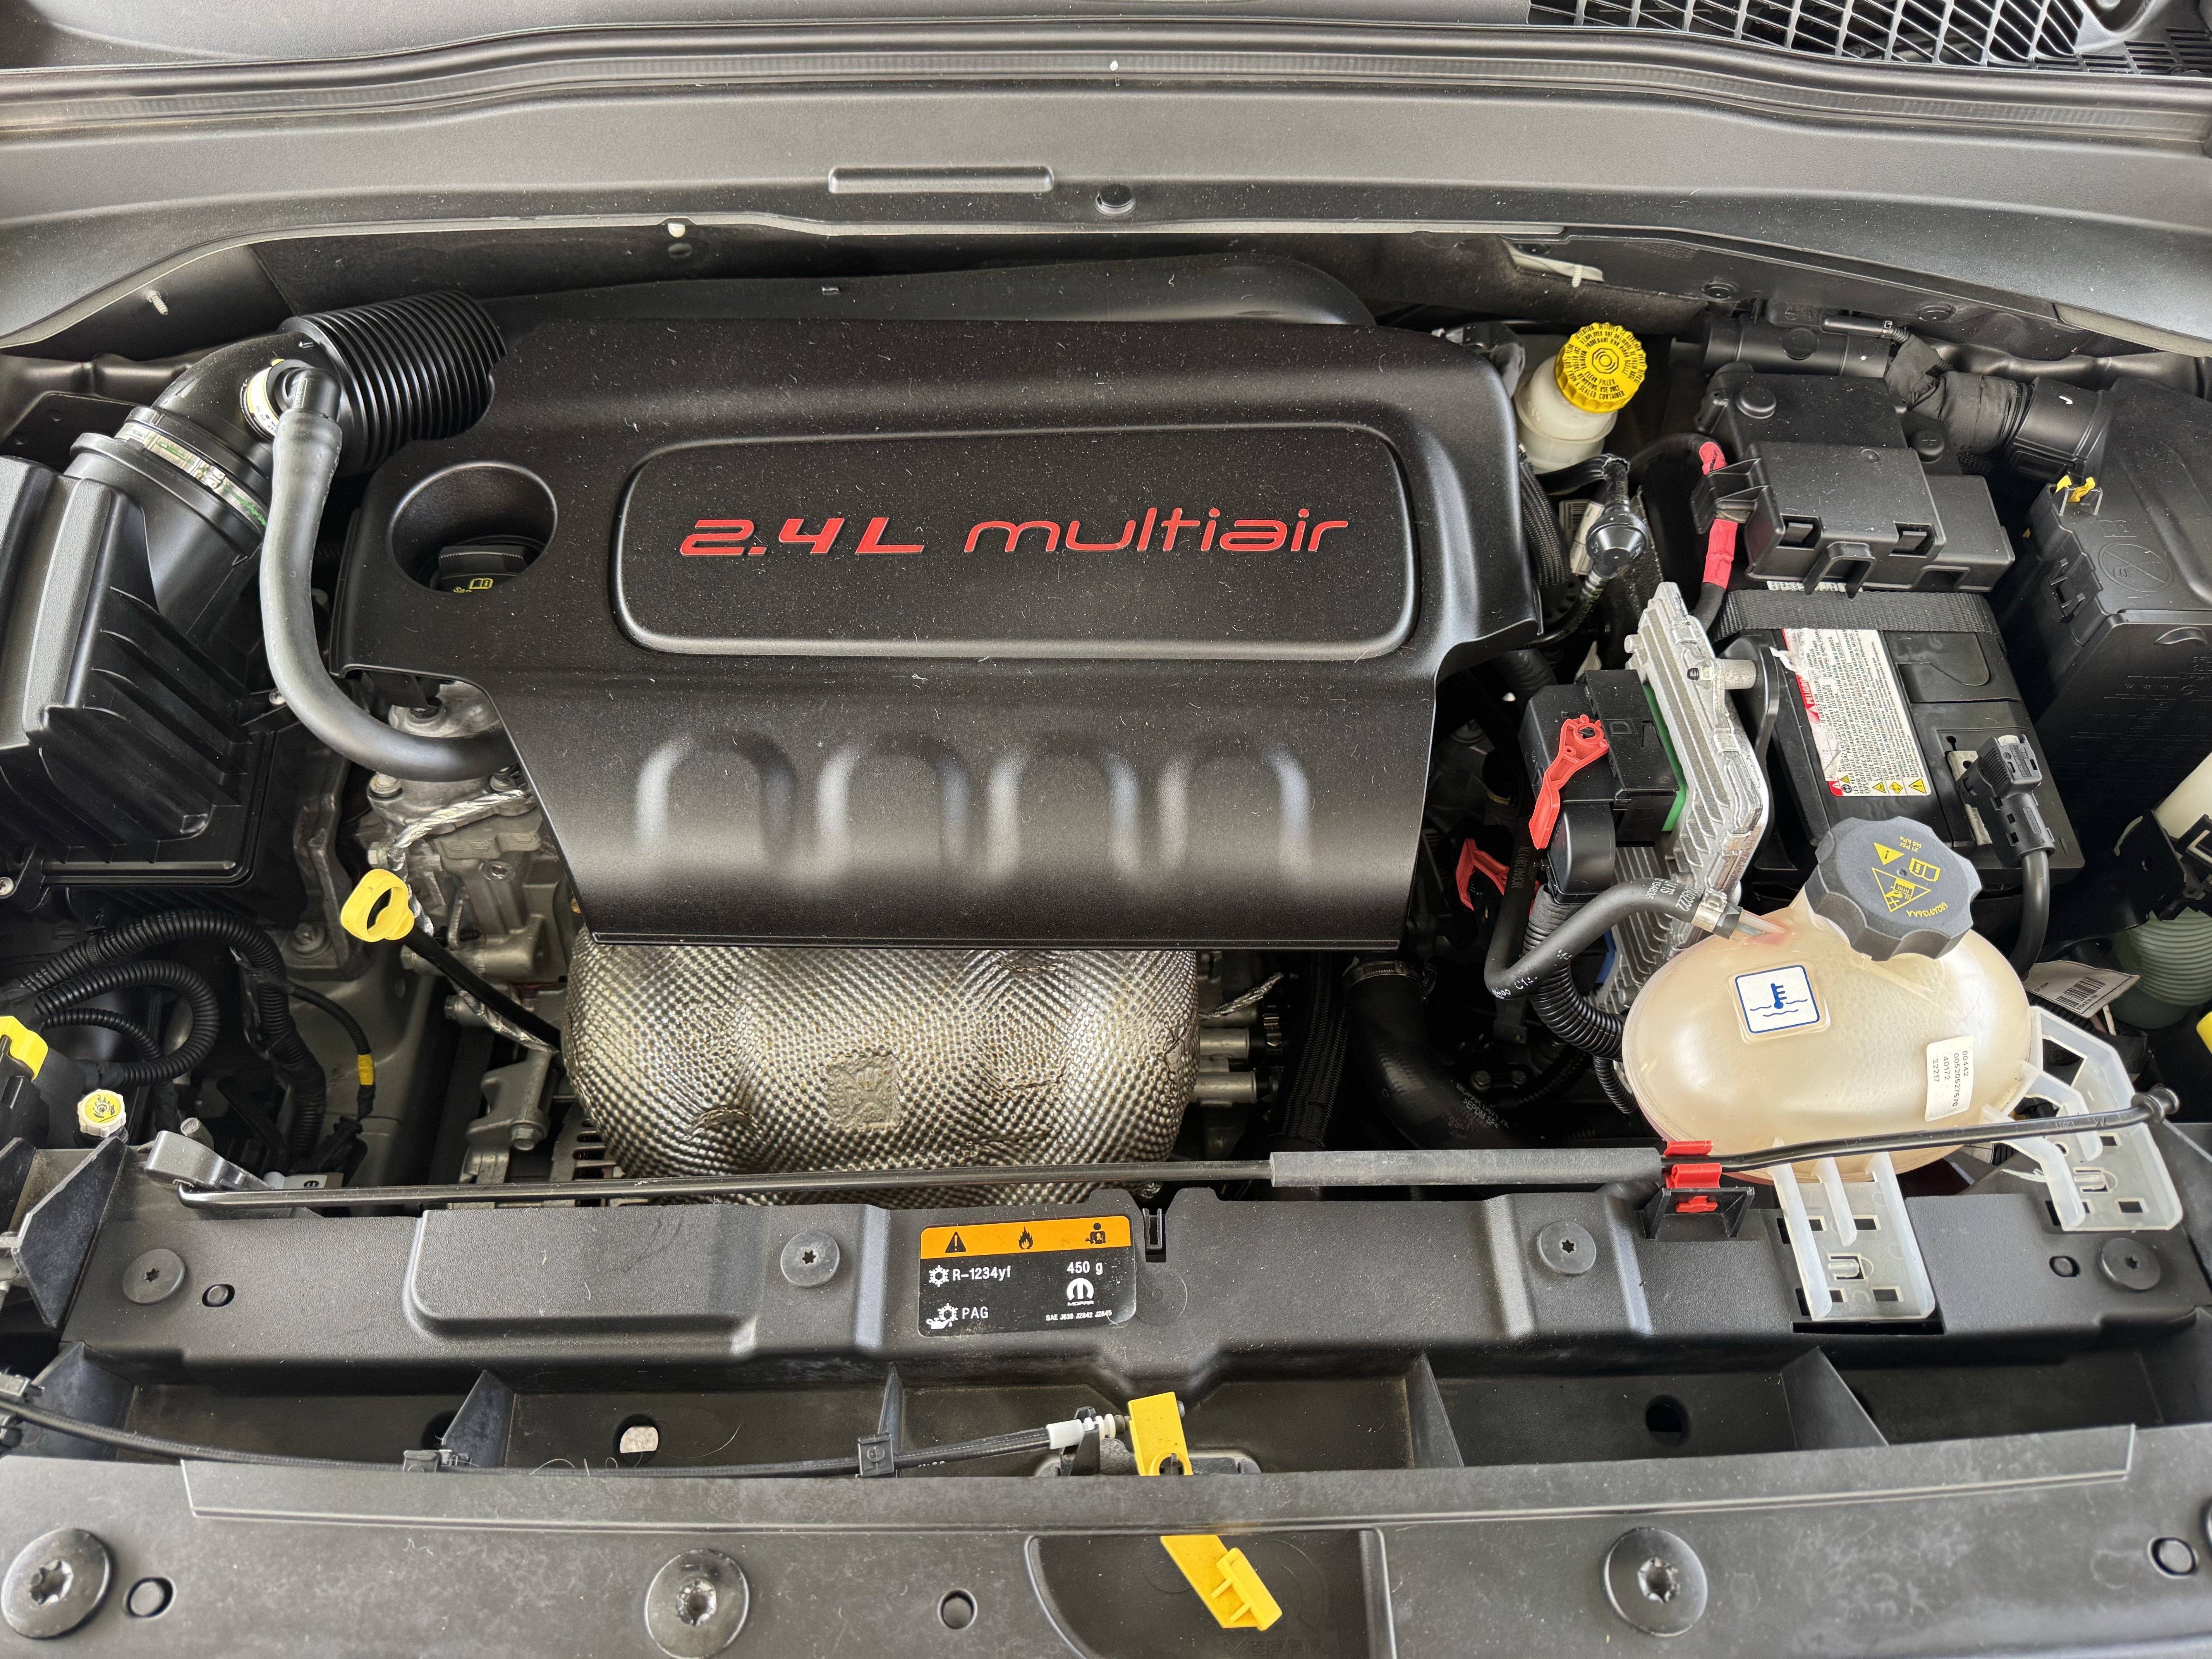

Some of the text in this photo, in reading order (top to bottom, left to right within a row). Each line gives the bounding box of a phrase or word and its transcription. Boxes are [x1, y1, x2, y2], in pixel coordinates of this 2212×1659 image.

[964, 507, 1348, 553] multiair
[1900, 843, 1911, 851] PSI
[1952, 1053, 1960, 1107] 00520527670
[953, 1261, 1103, 1281] R-1234yf 450 g
[962, 1306, 989, 1319] PAG
